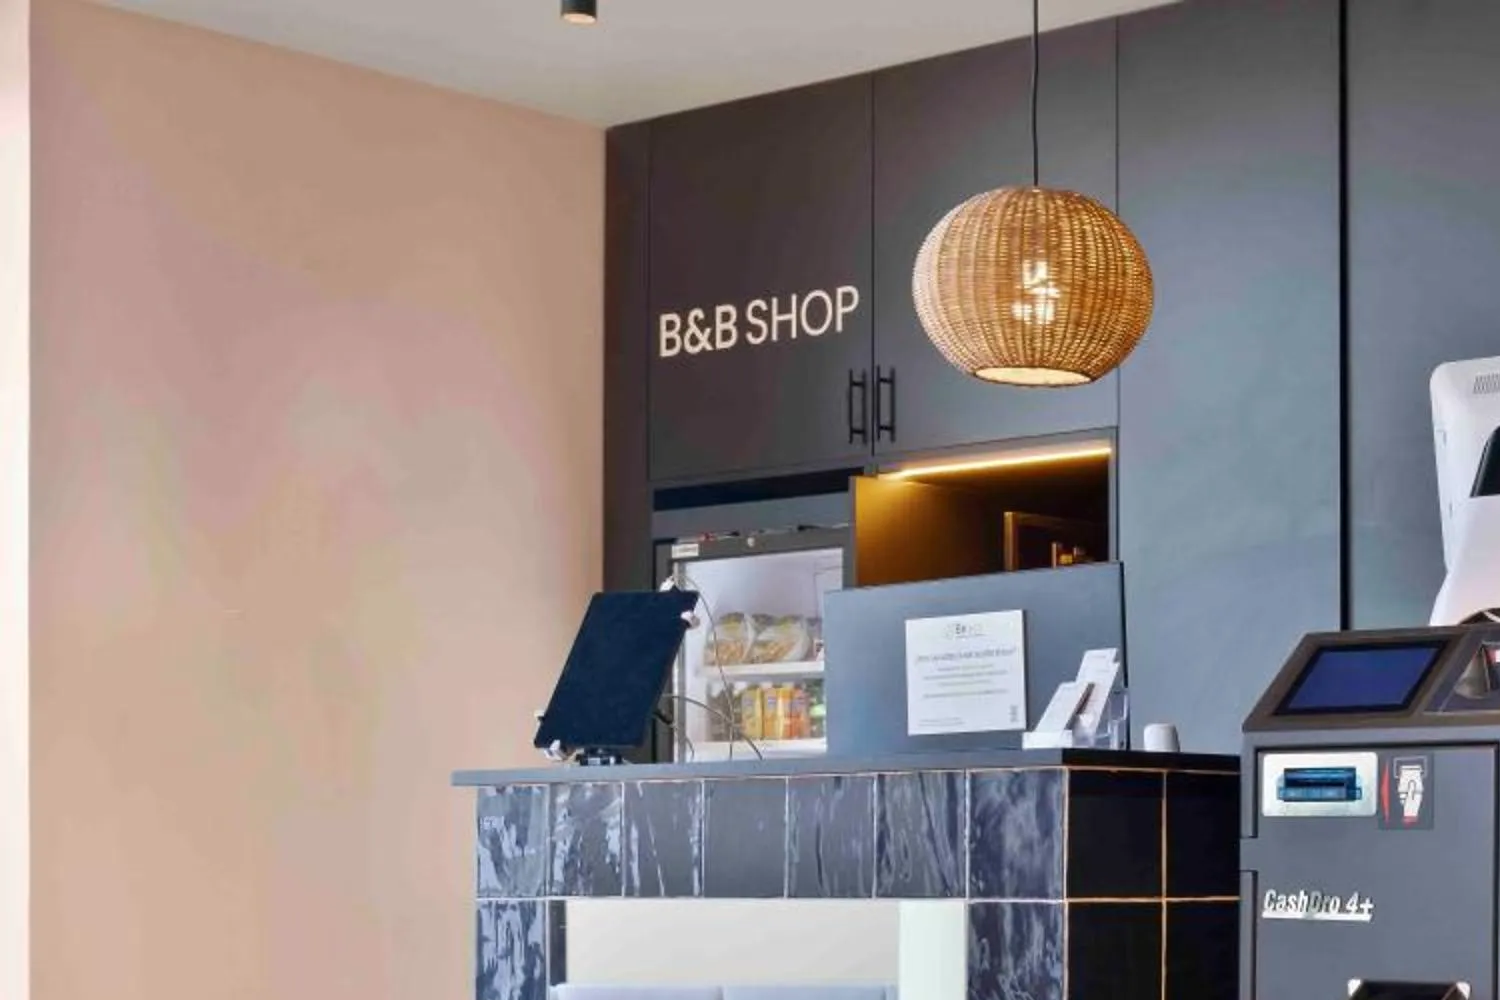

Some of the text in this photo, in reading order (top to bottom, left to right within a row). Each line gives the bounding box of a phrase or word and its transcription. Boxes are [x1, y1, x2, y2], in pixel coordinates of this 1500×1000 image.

[659, 285, 859, 357] B&B SHOP
[1263, 888, 1374, 915] CashDro 4+
